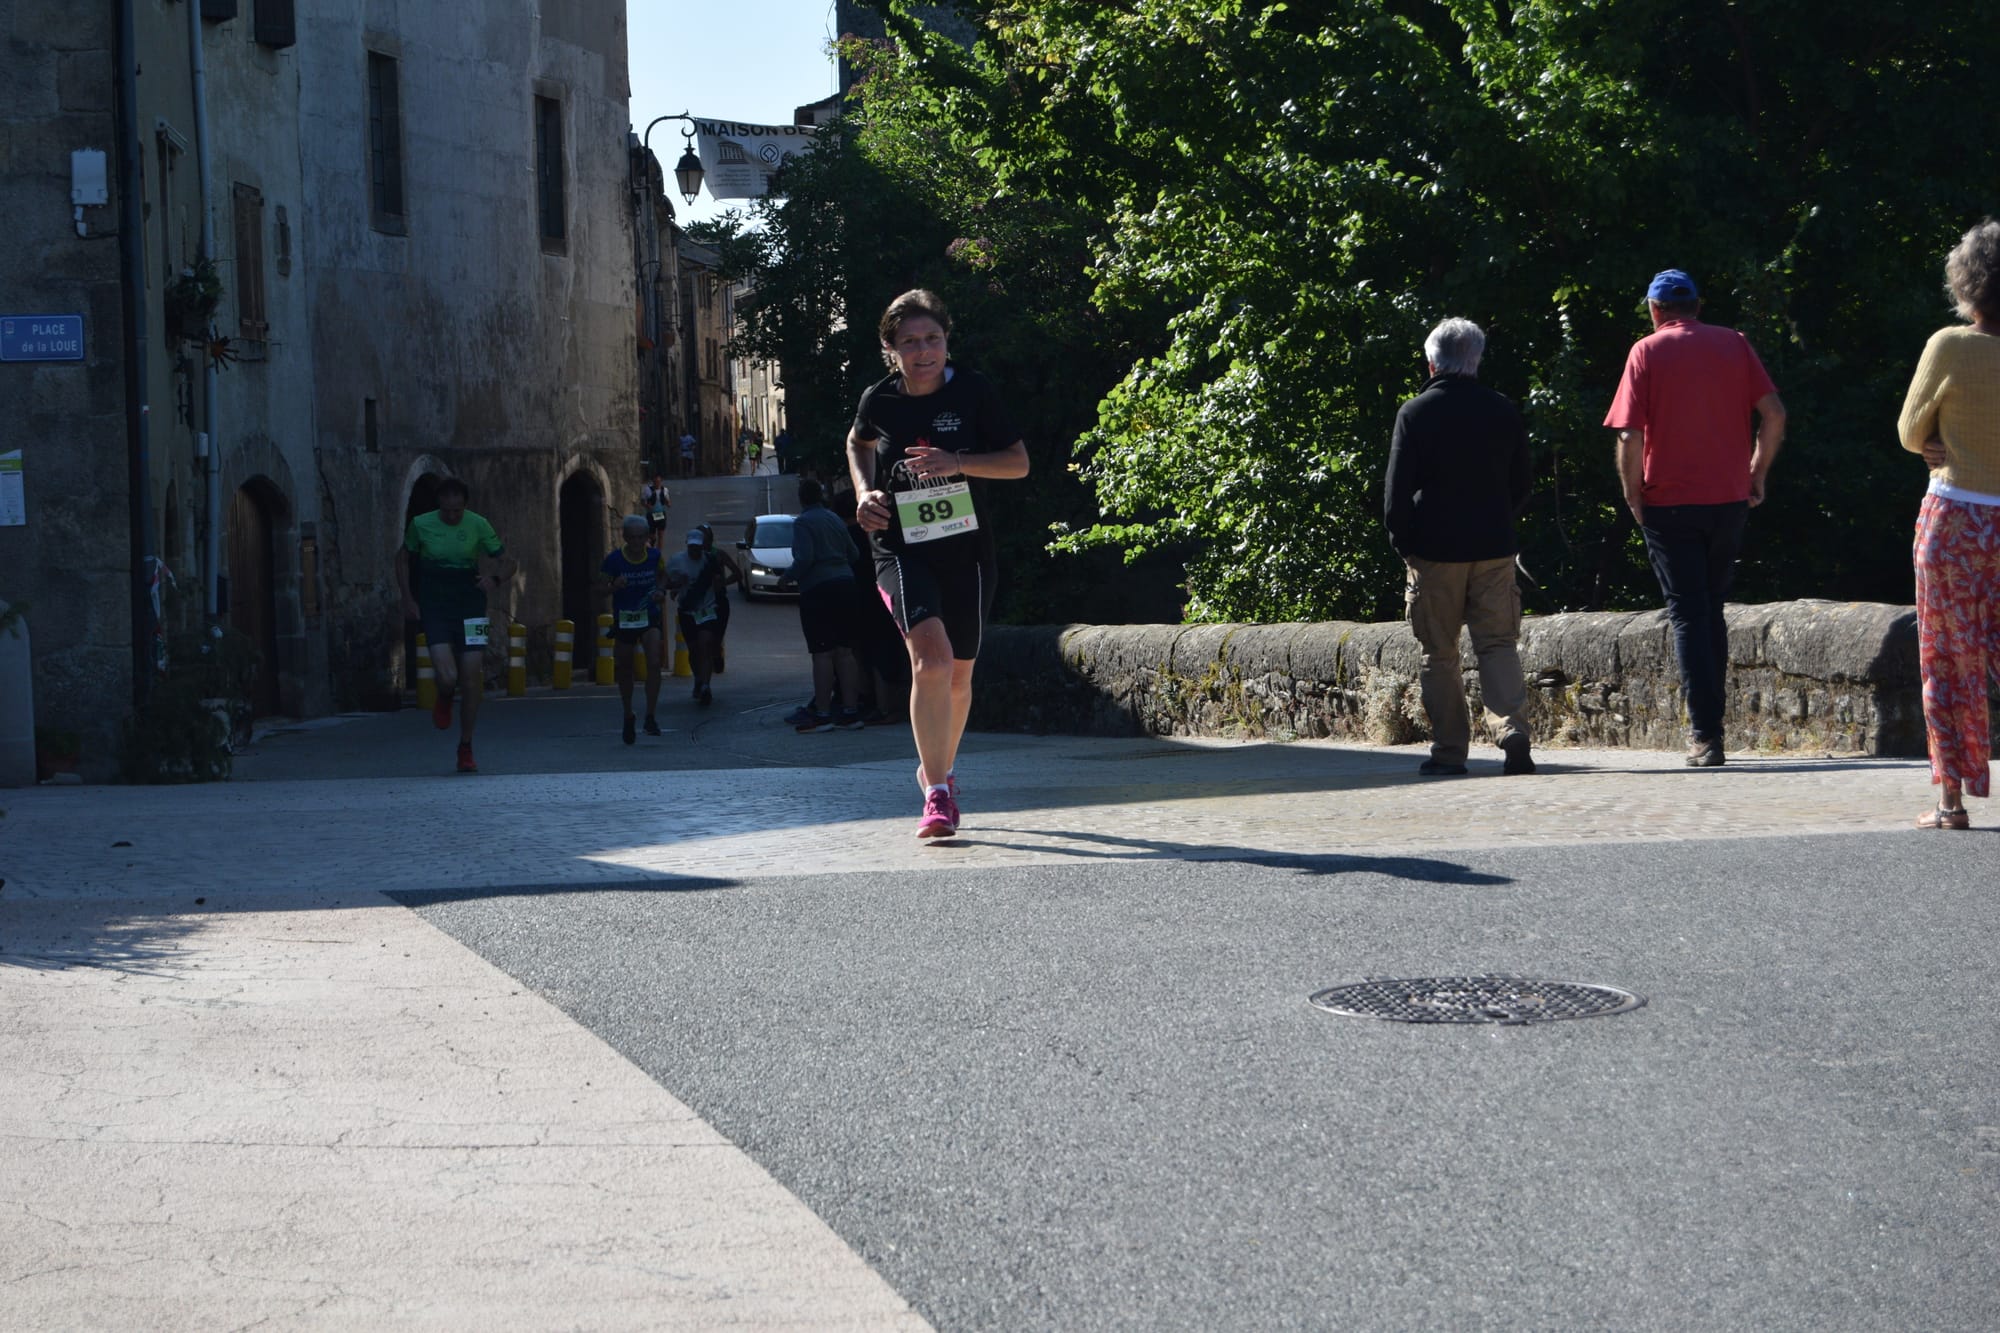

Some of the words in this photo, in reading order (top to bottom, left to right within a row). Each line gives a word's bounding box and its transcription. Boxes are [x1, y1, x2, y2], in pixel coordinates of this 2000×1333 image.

[701, 123, 778, 137] MAISON
[32, 323, 65, 336] PLACE
[22, 341, 34, 353] de
[38, 341, 47, 352] la
[50, 340, 78, 352] LOUE
[918, 500, 953, 524] 89
